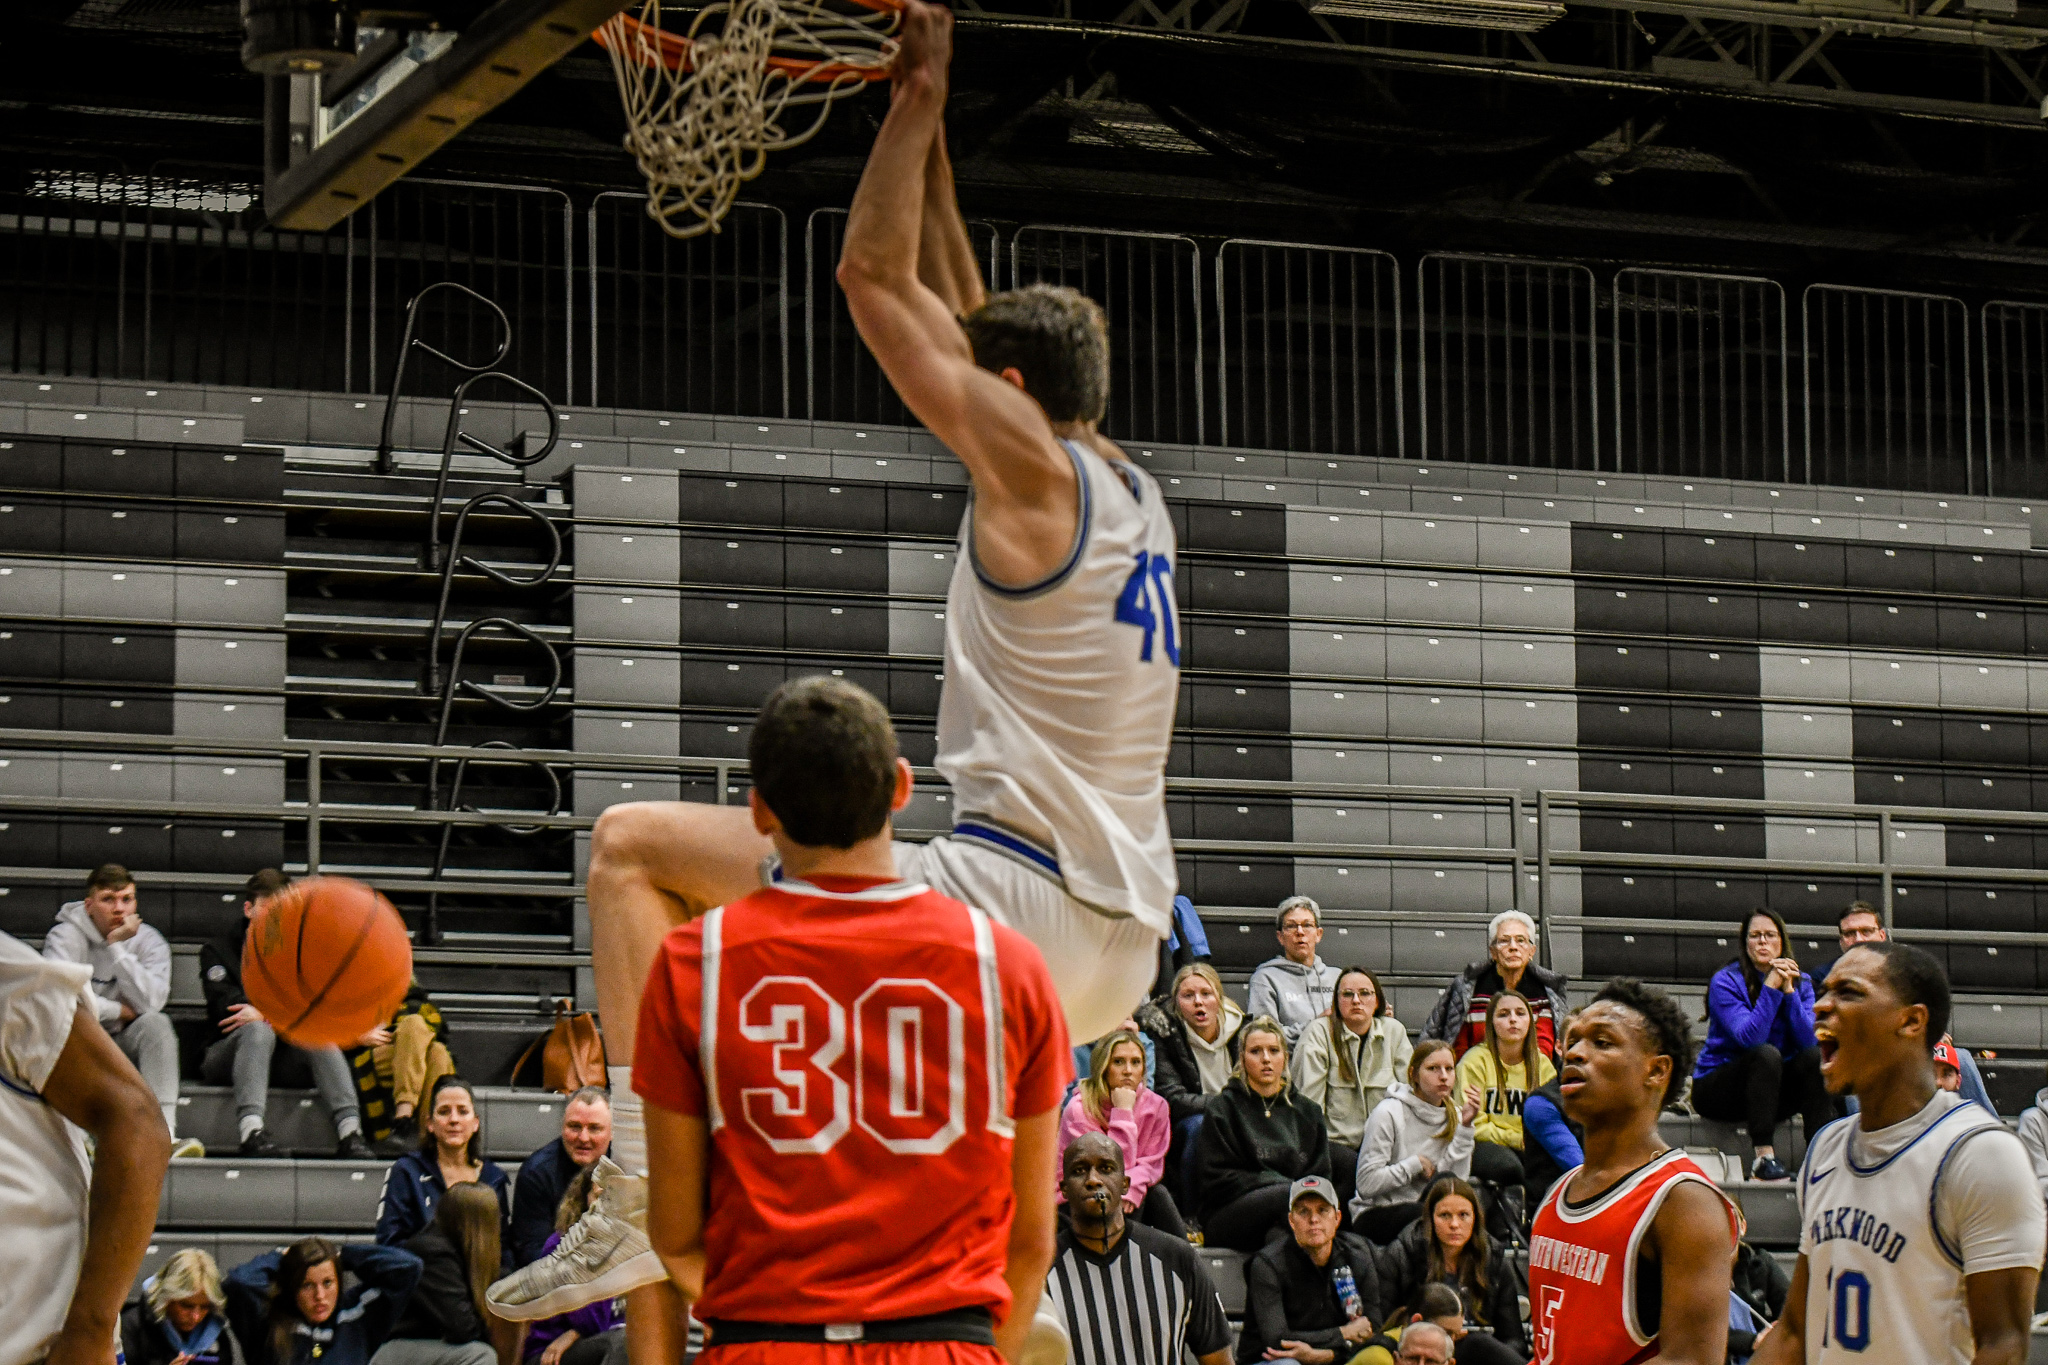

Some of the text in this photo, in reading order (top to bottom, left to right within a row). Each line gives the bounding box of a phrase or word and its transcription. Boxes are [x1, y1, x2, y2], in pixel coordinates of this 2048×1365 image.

[1114, 550, 1180, 667] 40
[739, 975, 966, 1154] 30
[1485, 1088, 1526, 1115] IOW
[1536, 1284, 1565, 1365] 5
